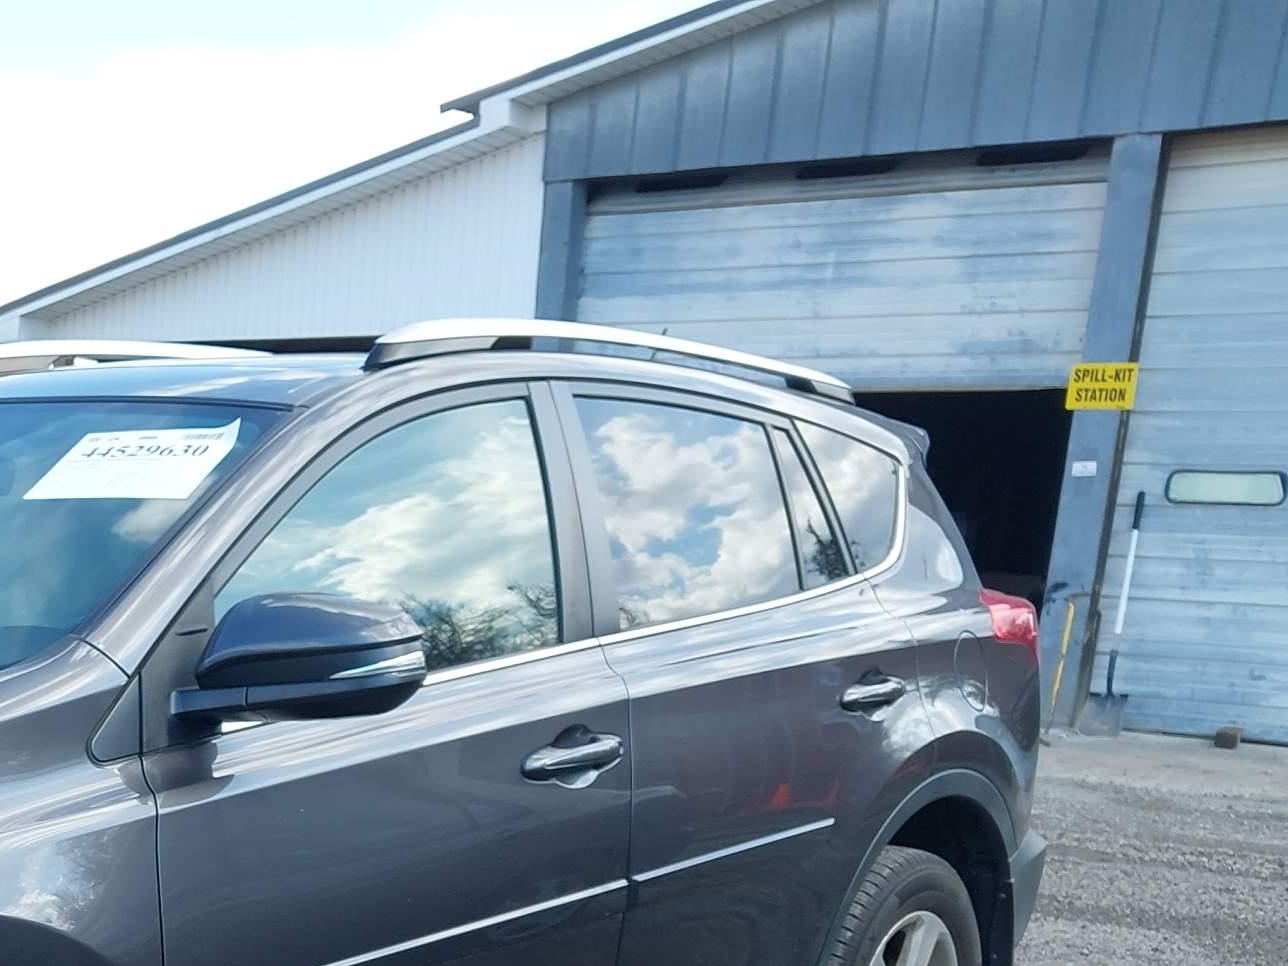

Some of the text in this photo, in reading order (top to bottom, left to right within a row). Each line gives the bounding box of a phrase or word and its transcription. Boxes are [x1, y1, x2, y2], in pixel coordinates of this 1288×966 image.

[1073, 368, 1134, 382] SPILL-KIT
[1075, 388, 1126, 402] STATION
[81, 444, 210, 458] 44529630
